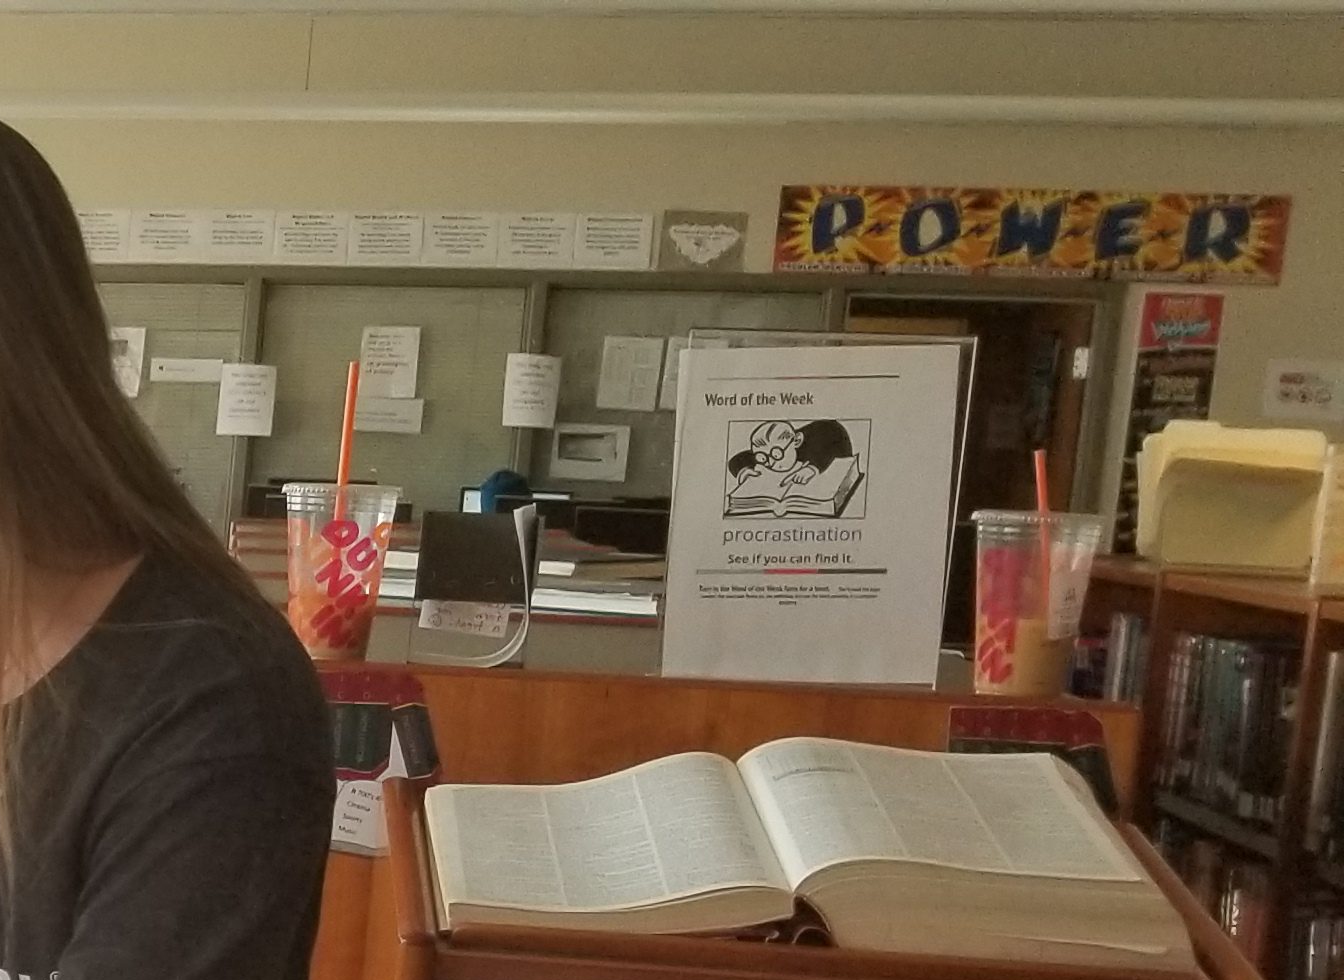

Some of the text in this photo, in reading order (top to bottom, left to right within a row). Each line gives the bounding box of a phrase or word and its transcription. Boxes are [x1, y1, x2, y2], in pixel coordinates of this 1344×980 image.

[811, 192, 1254, 262] POWER
[705, 391, 814, 406] Word of the Week
[722, 526, 863, 545] procrastination
[728, 553, 749, 565] See
[752, 553, 762, 565] if
[763, 555, 787, 567] you
[789, 555, 811, 565] can
[815, 552, 839, 565] find
